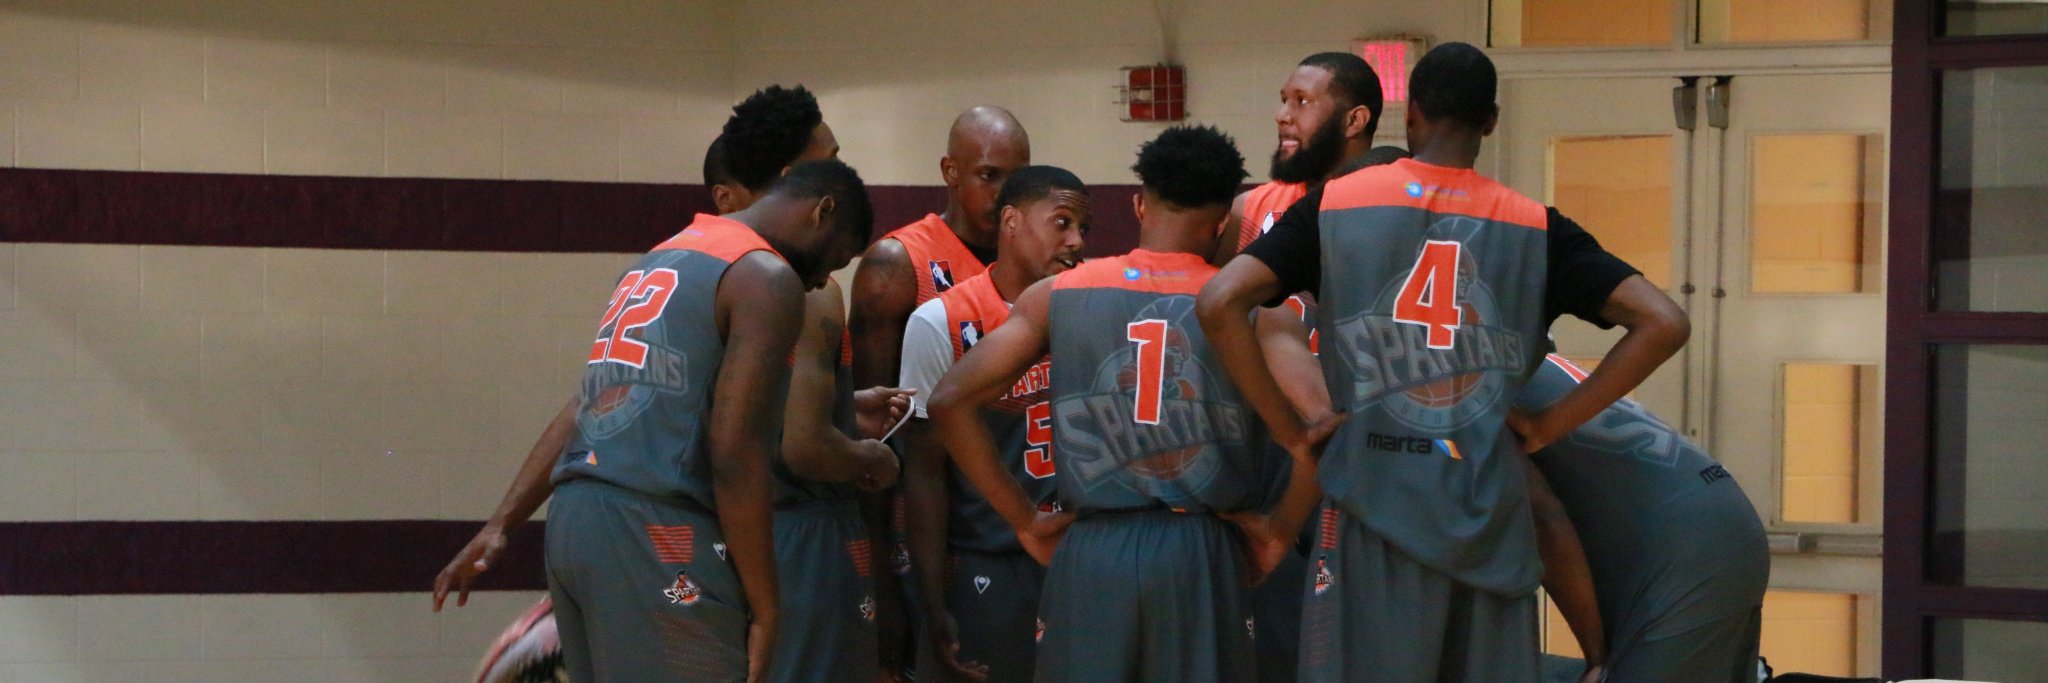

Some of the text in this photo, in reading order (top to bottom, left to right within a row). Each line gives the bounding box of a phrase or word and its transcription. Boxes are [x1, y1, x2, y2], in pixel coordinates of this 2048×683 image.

[587, 268, 678, 369] 22
[1392, 239, 1462, 349] 4
[1127, 318, 1168, 425] 1
[1024, 401, 1056, 480] 5
[1366, 432, 1432, 454] marta
